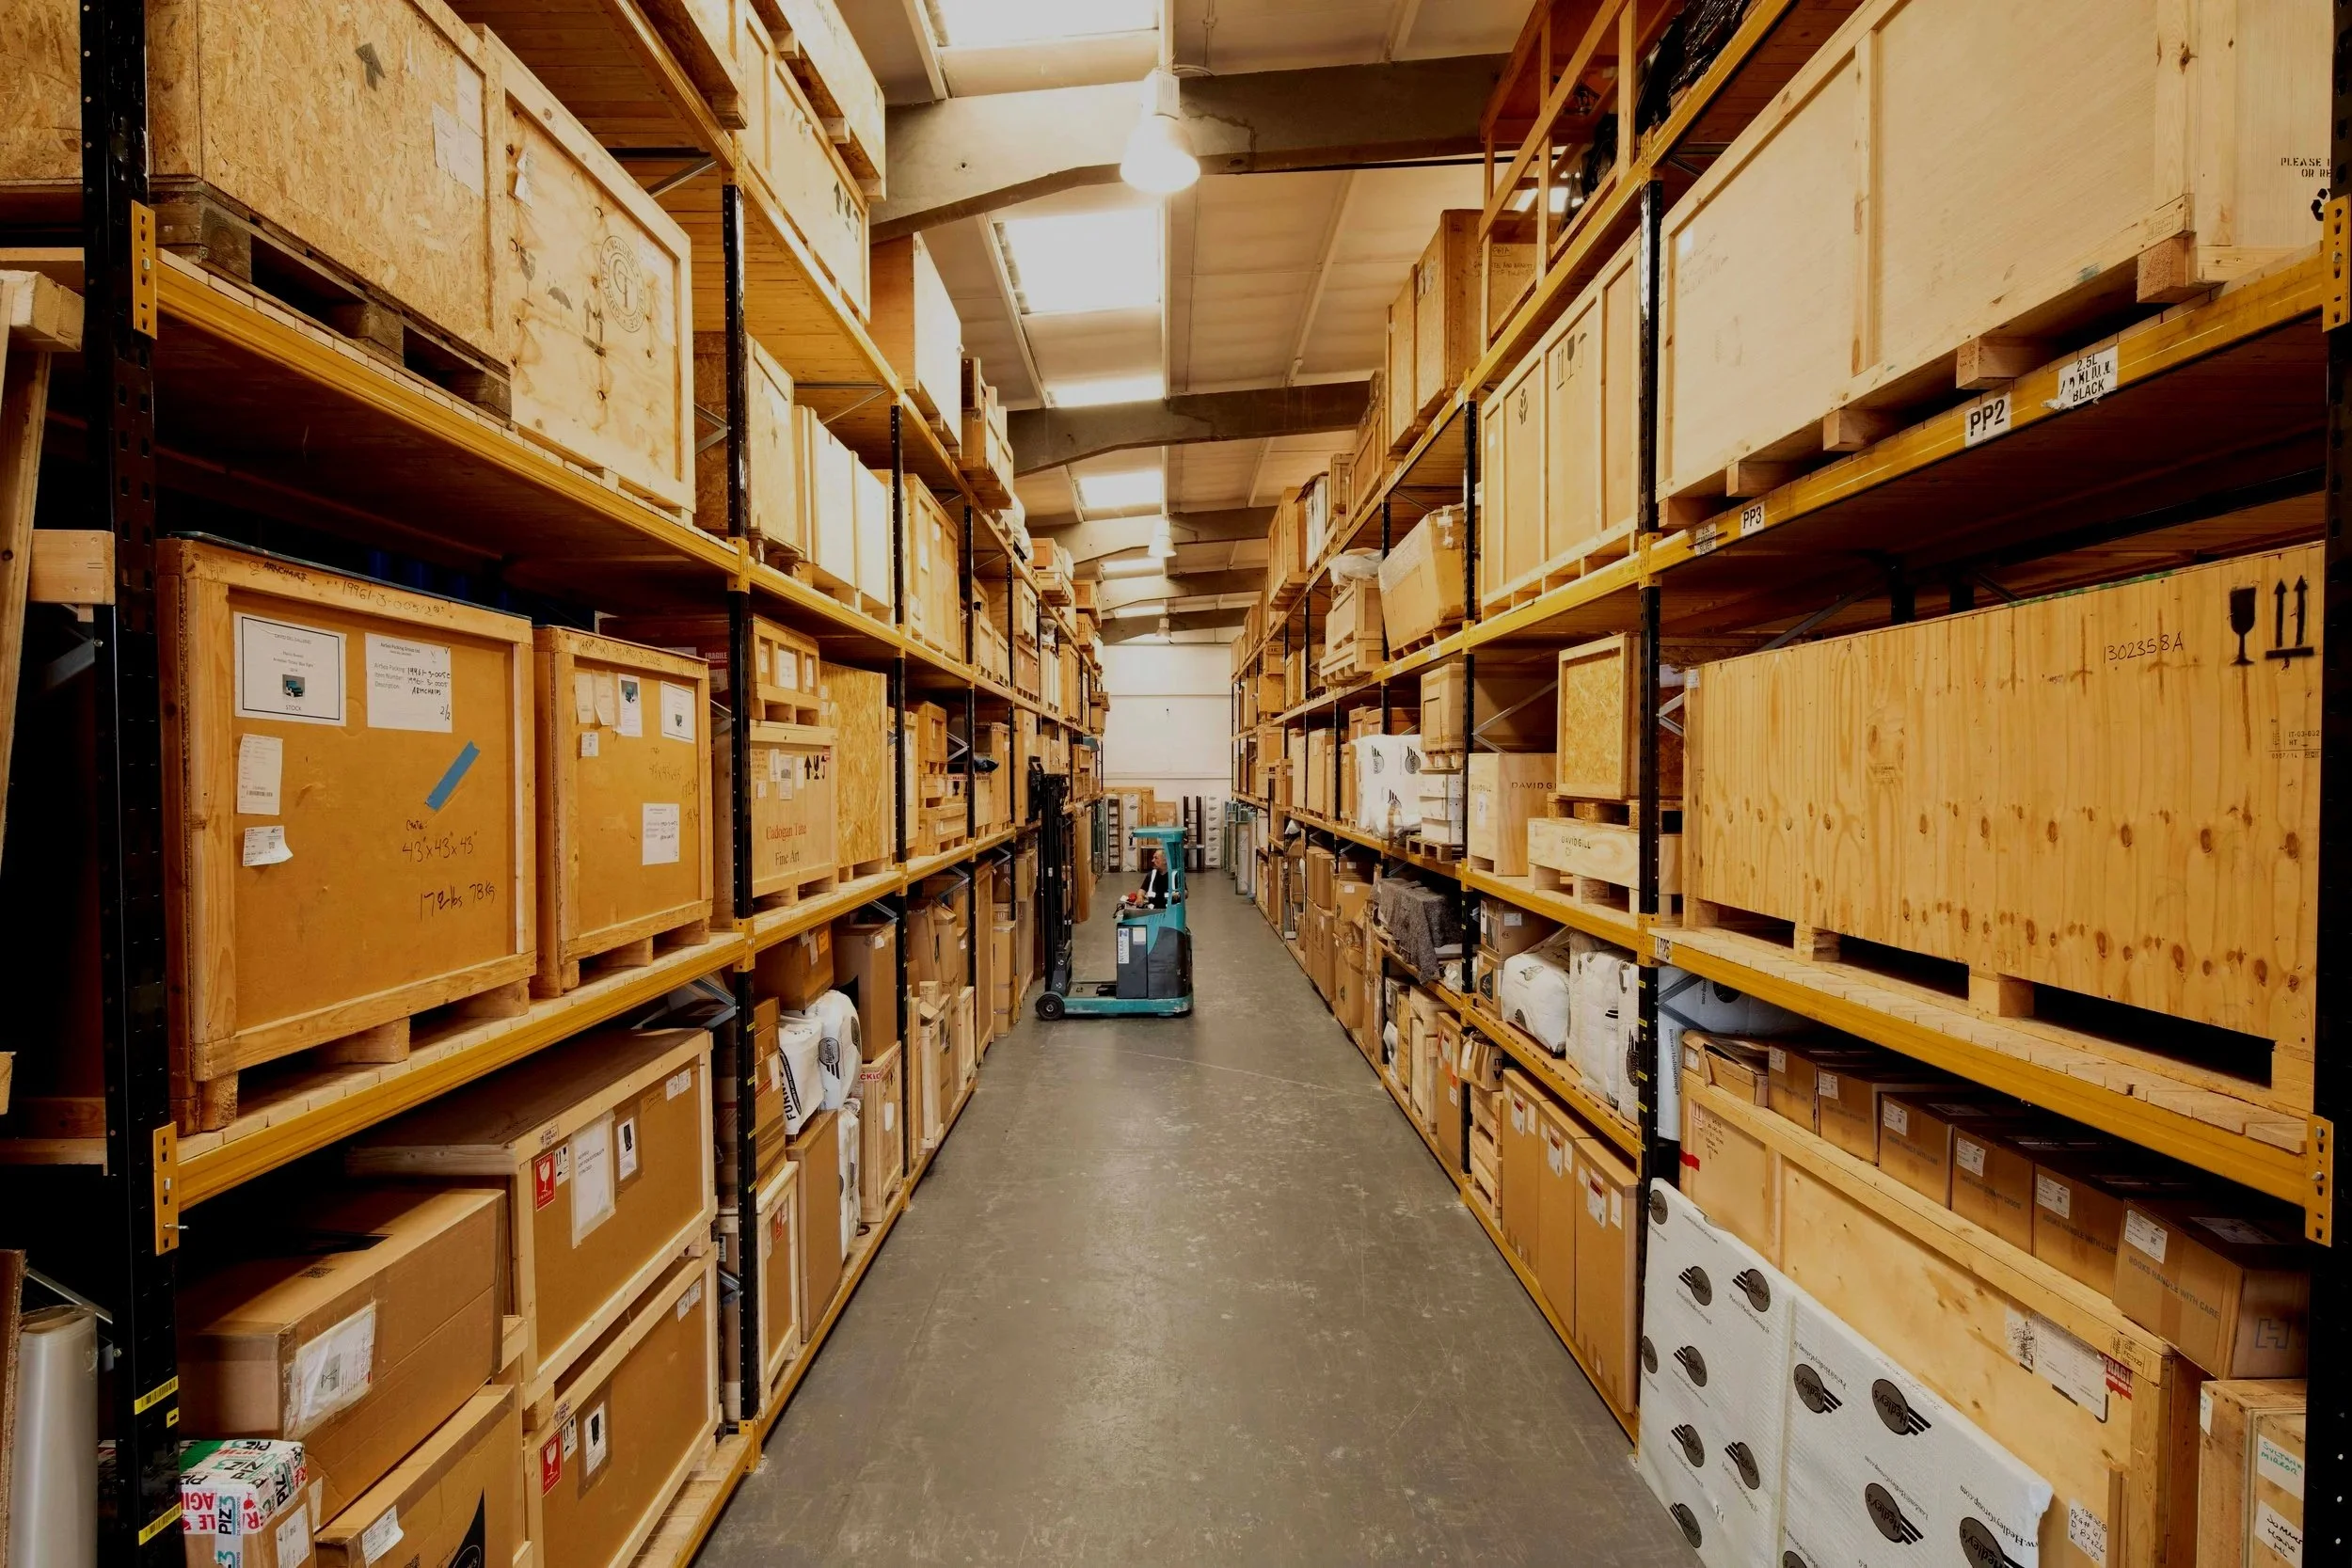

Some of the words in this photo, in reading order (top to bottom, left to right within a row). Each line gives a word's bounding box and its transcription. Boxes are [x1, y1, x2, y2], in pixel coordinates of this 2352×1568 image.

[2280, 158, 2322, 166] PLEASE
[2301, 169, 2314, 178] OR
[2073, 379, 2106, 403] BLACK
[1970, 399, 2005, 437] PP2
[1743, 506, 1763, 529] PP3
[2103, 631, 2185, 664] 1302358A
[767, 825, 792, 841] Cadogan
[795, 823, 806, 835] Tate
[775, 851, 788, 865] Fine
[790, 850, 799, 863] Art
[1747, 1277, 1770, 1304] Hedley's
[2128, 1255, 2151, 1275] BOOKS
[2152, 1270, 2179, 1294] HANDLE
[2180, 1289, 2199, 1307] WITH
[2200, 1301, 2220, 1319] CARE
[1796, 1372, 1823, 1405] Hedley's
[1873, 1388, 1909, 1427] Hedley's
[1867, 1492, 1900, 1535] Hedley's
